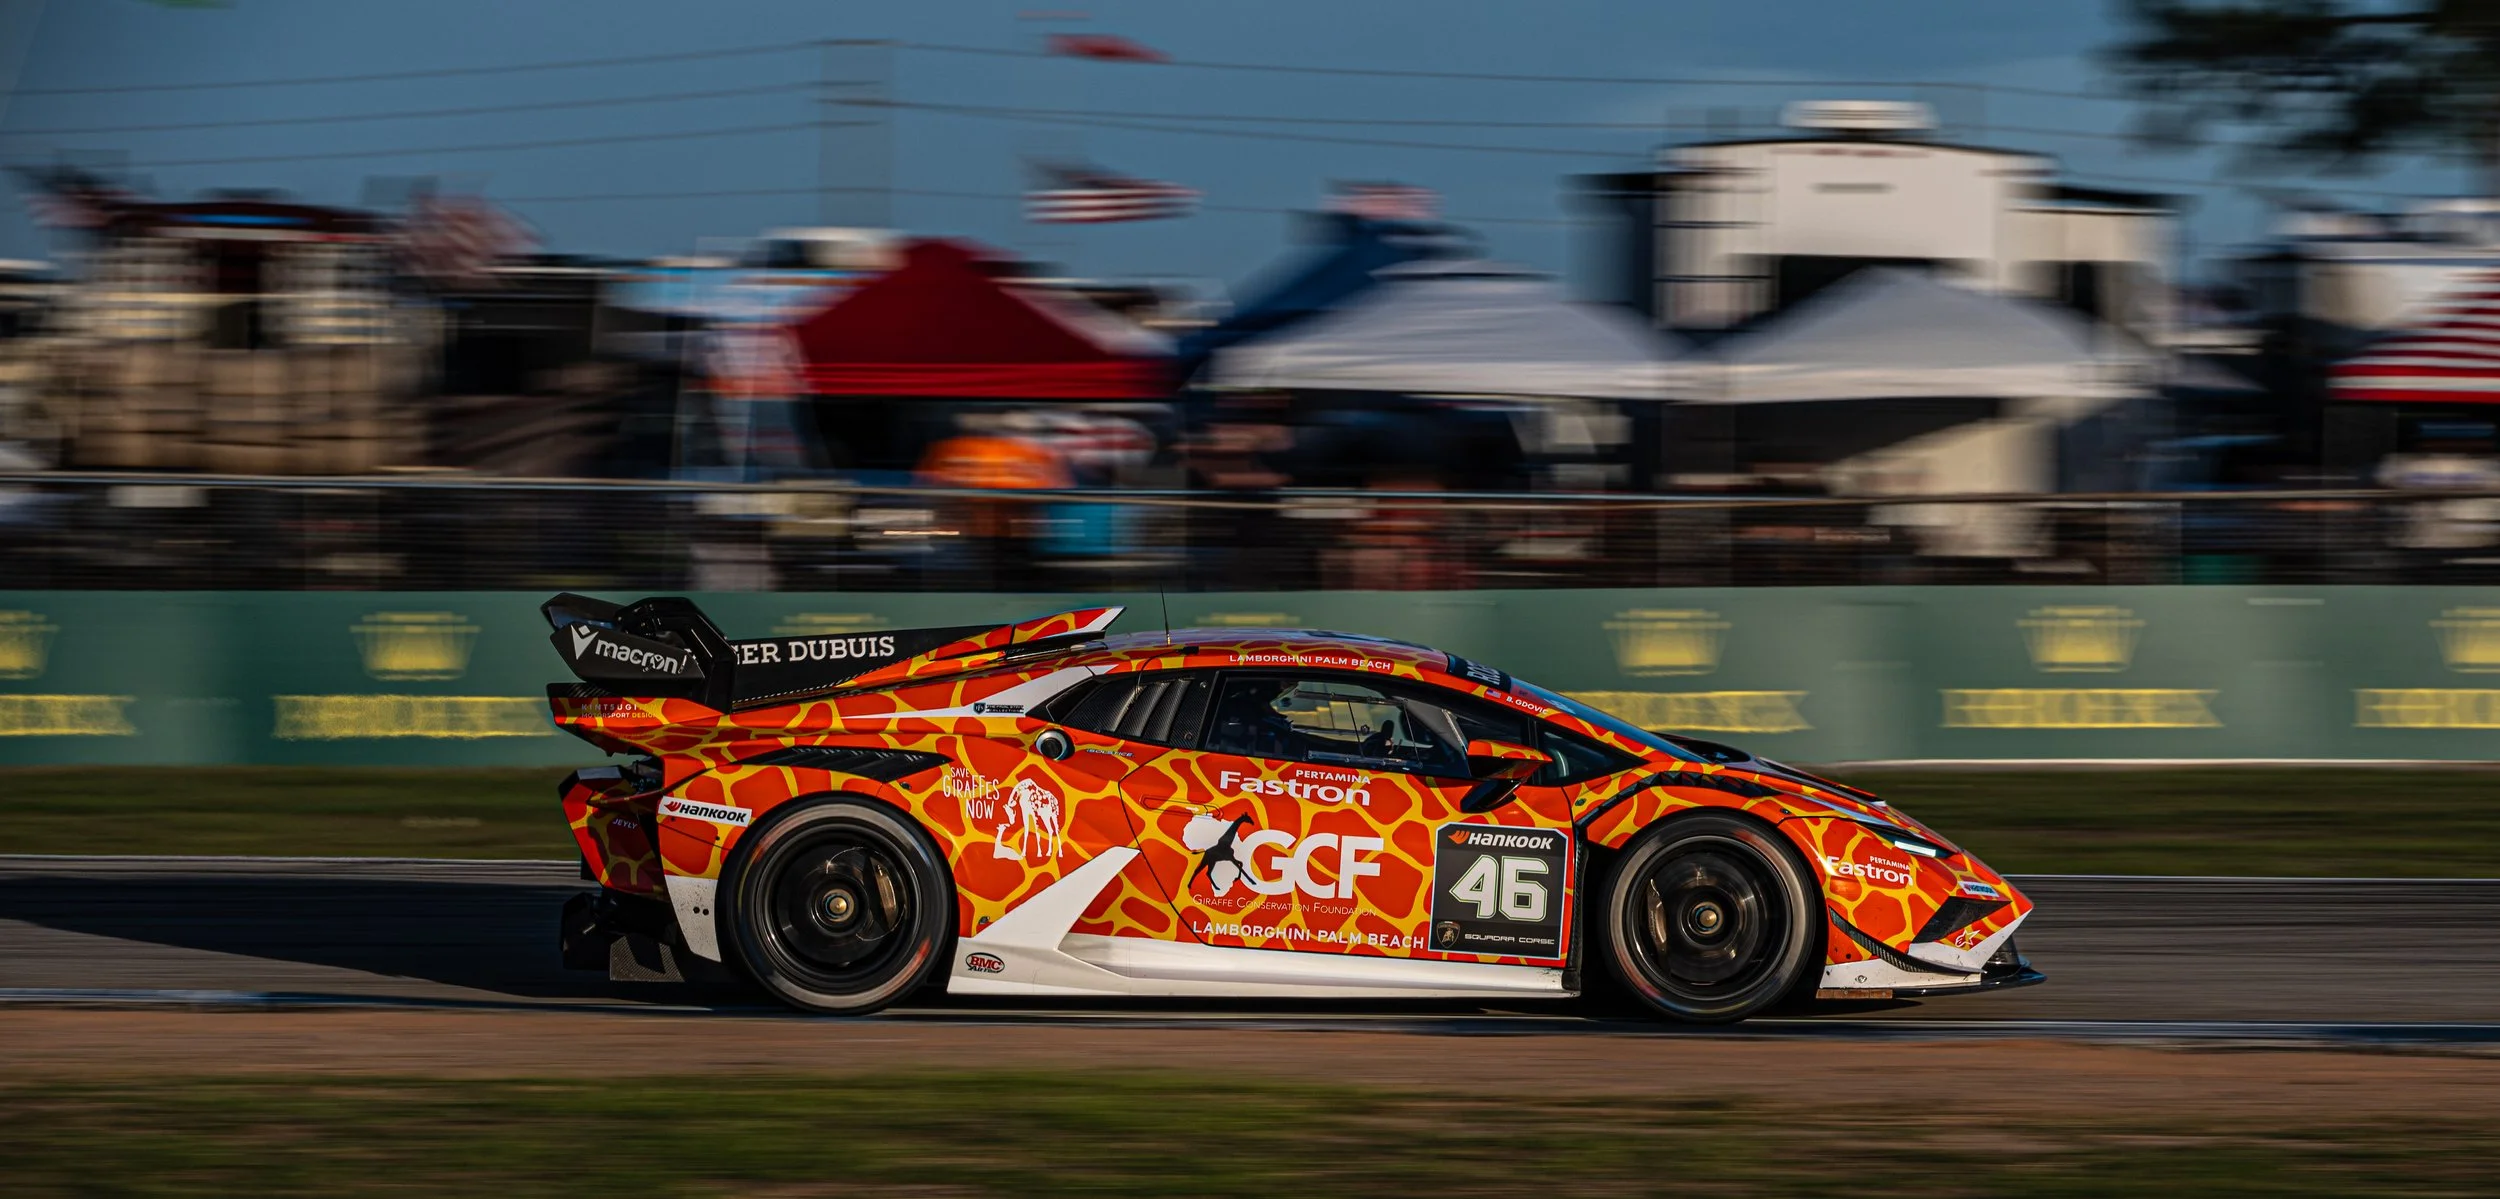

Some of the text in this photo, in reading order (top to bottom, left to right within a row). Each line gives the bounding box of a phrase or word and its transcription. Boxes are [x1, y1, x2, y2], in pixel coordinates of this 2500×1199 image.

[595, 639, 678, 674] macron
[789, 636, 895, 662] DUBUIS
[1229, 654, 1391, 670] LAMBORGHINI PALM BEACH
[581, 703, 637, 711] KINTSUGI
[1515, 700, 1549, 714] GDOVIC
[951, 766, 970, 778] SAVE
[1295, 769, 1371, 785] PERTAMINA
[943, 774, 1000, 801] GIRAFFES
[1219, 770, 1370, 807] Fastron
[966, 799, 994, 819] NOW
[1238, 829, 1384, 899] GCF
[1826, 855, 1914, 887] Fastron
[1869, 855, 1911, 871] PERTAMINA
[1449, 854, 1549, 922] 46
[1192, 894, 1377, 917] GIRAFFE CONSERVATION FOUNDATION
[1192, 920, 1424, 949] LAMBORGHINI PALM BEACH
[1464, 933, 1555, 945] SQUADRA CORSE
[970, 956, 1001, 971] BMC
